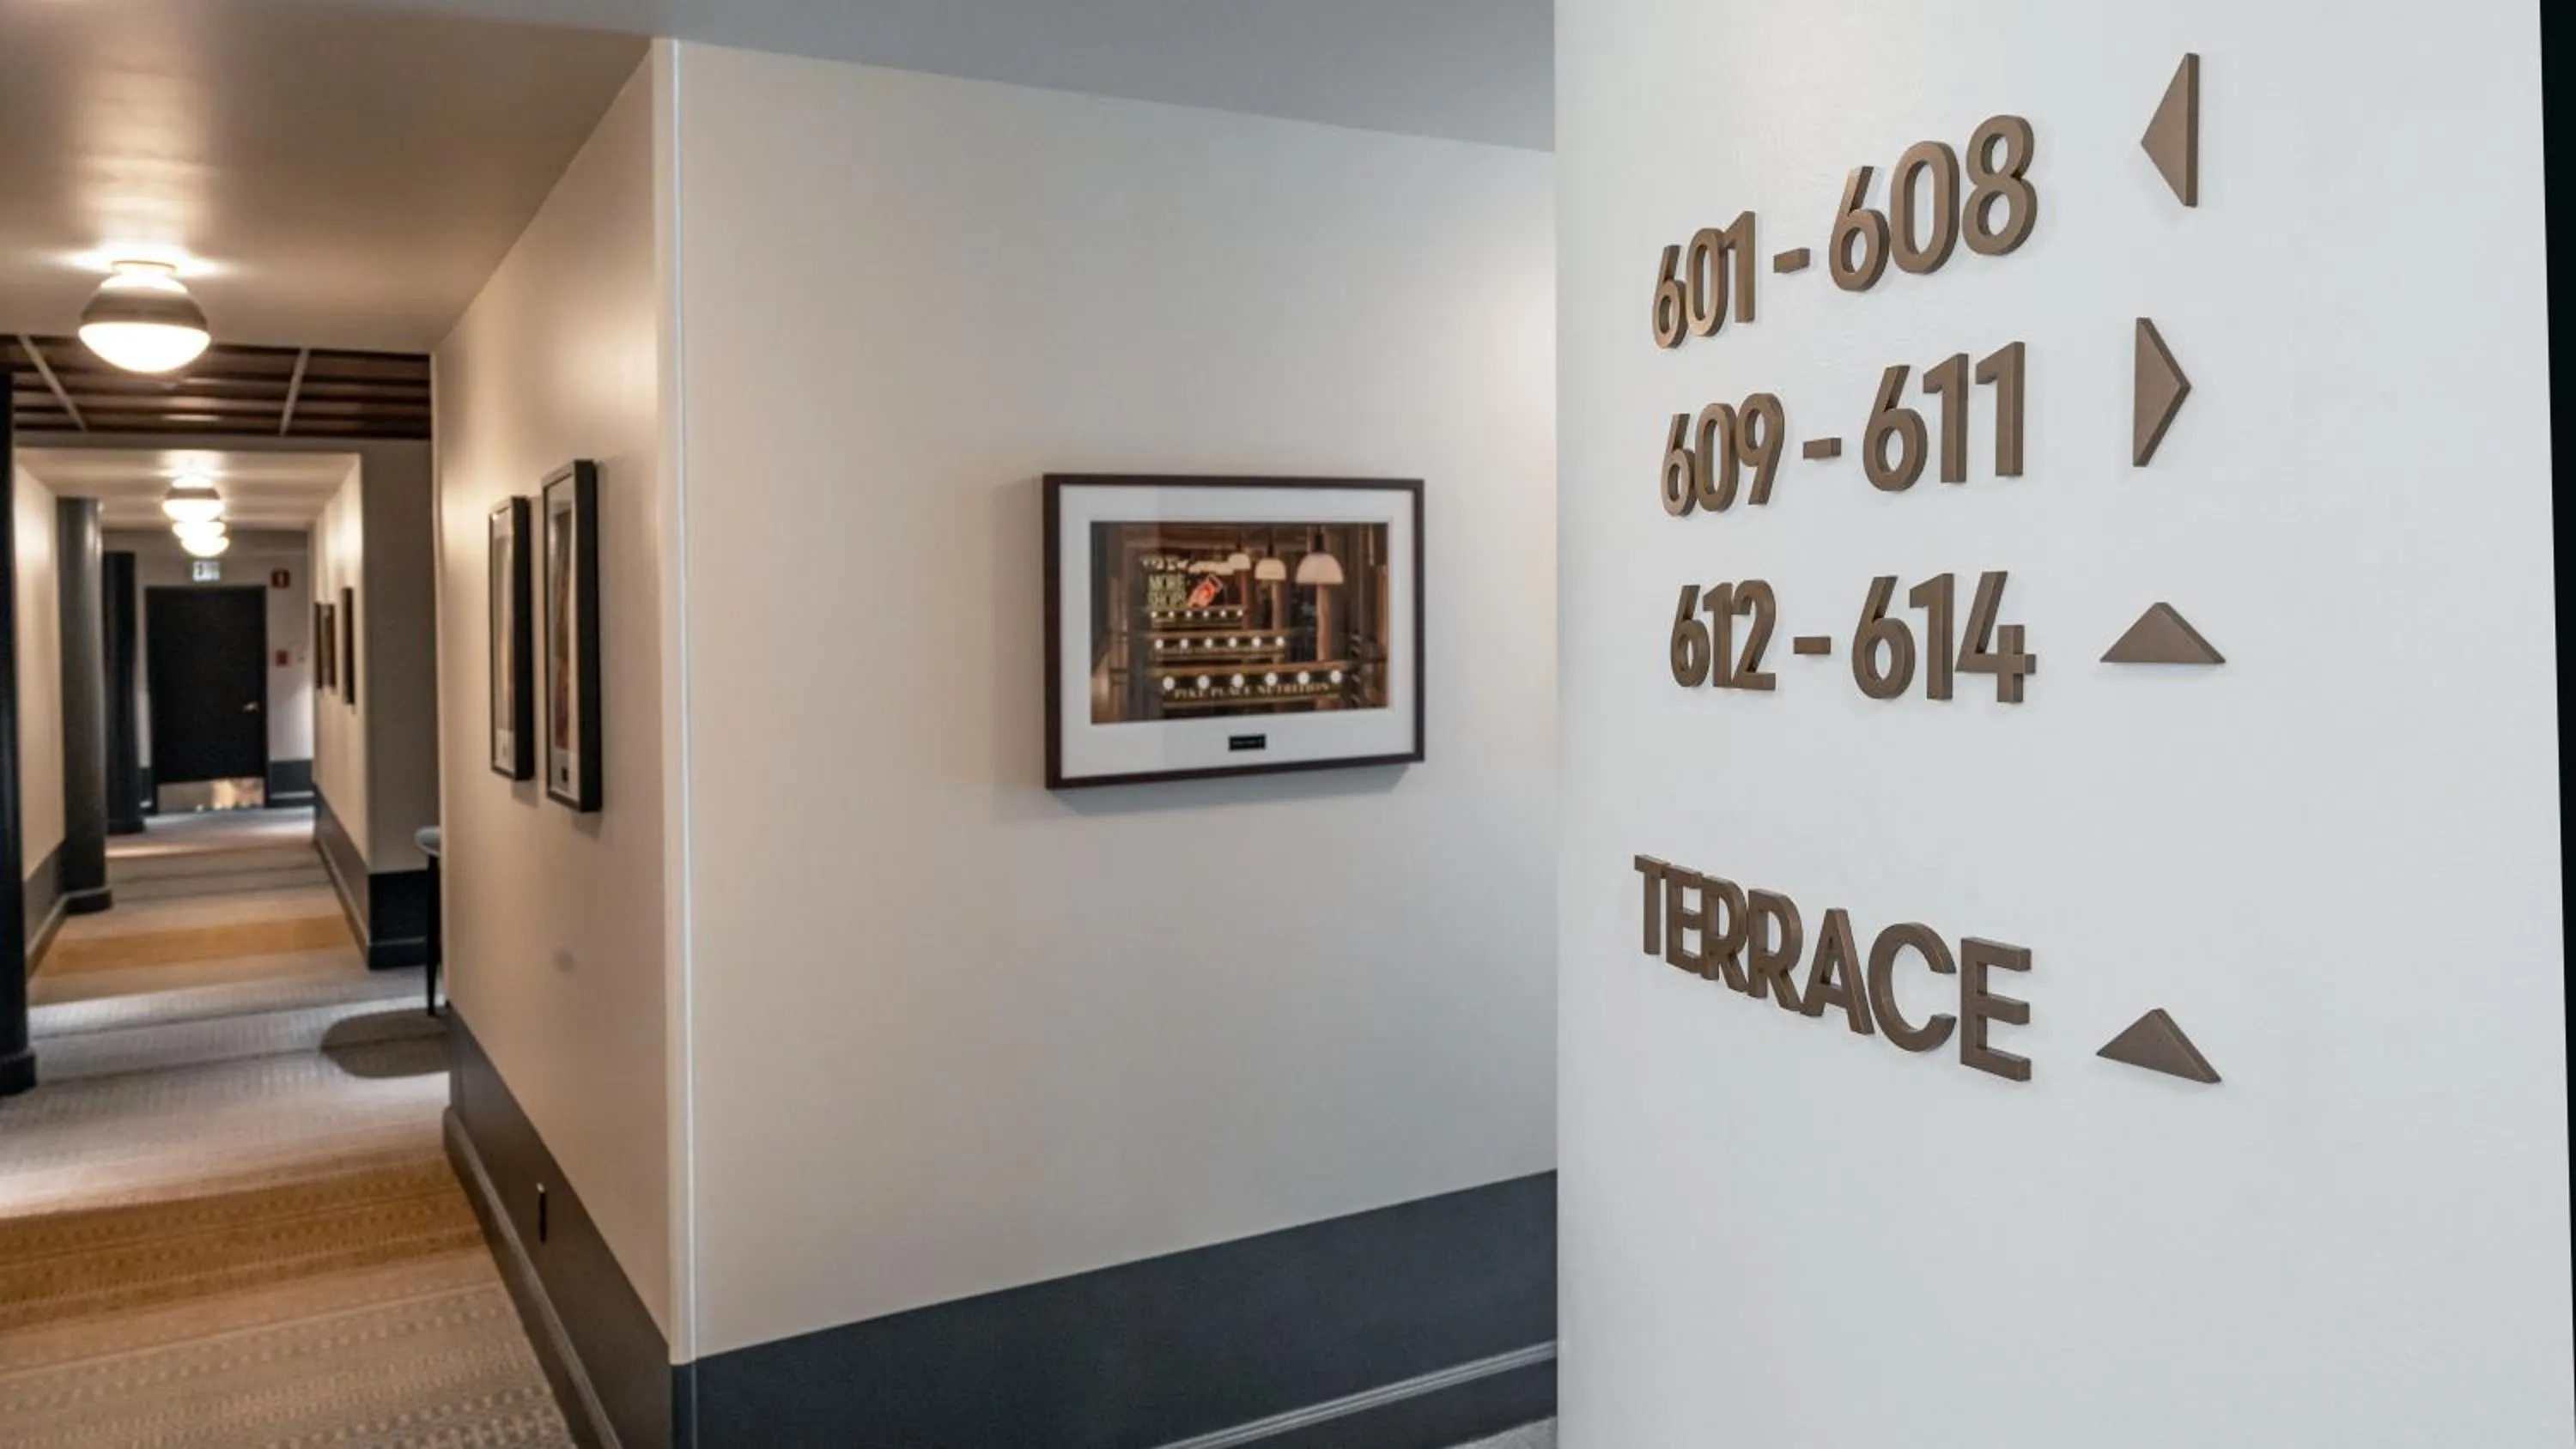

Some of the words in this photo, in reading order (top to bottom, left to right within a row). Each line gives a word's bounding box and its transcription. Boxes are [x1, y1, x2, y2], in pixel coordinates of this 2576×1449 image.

[1652, 210, 1755, 349] 601
[1829, 114, 2038, 293] 608
[1662, 393, 1784, 517] 609
[1862, 342, 2025, 493] 611
[1670, 579, 1776, 691] 612
[1851, 571, 2037, 703] 614
[1634, 854, 2032, 1082] TERRACE
